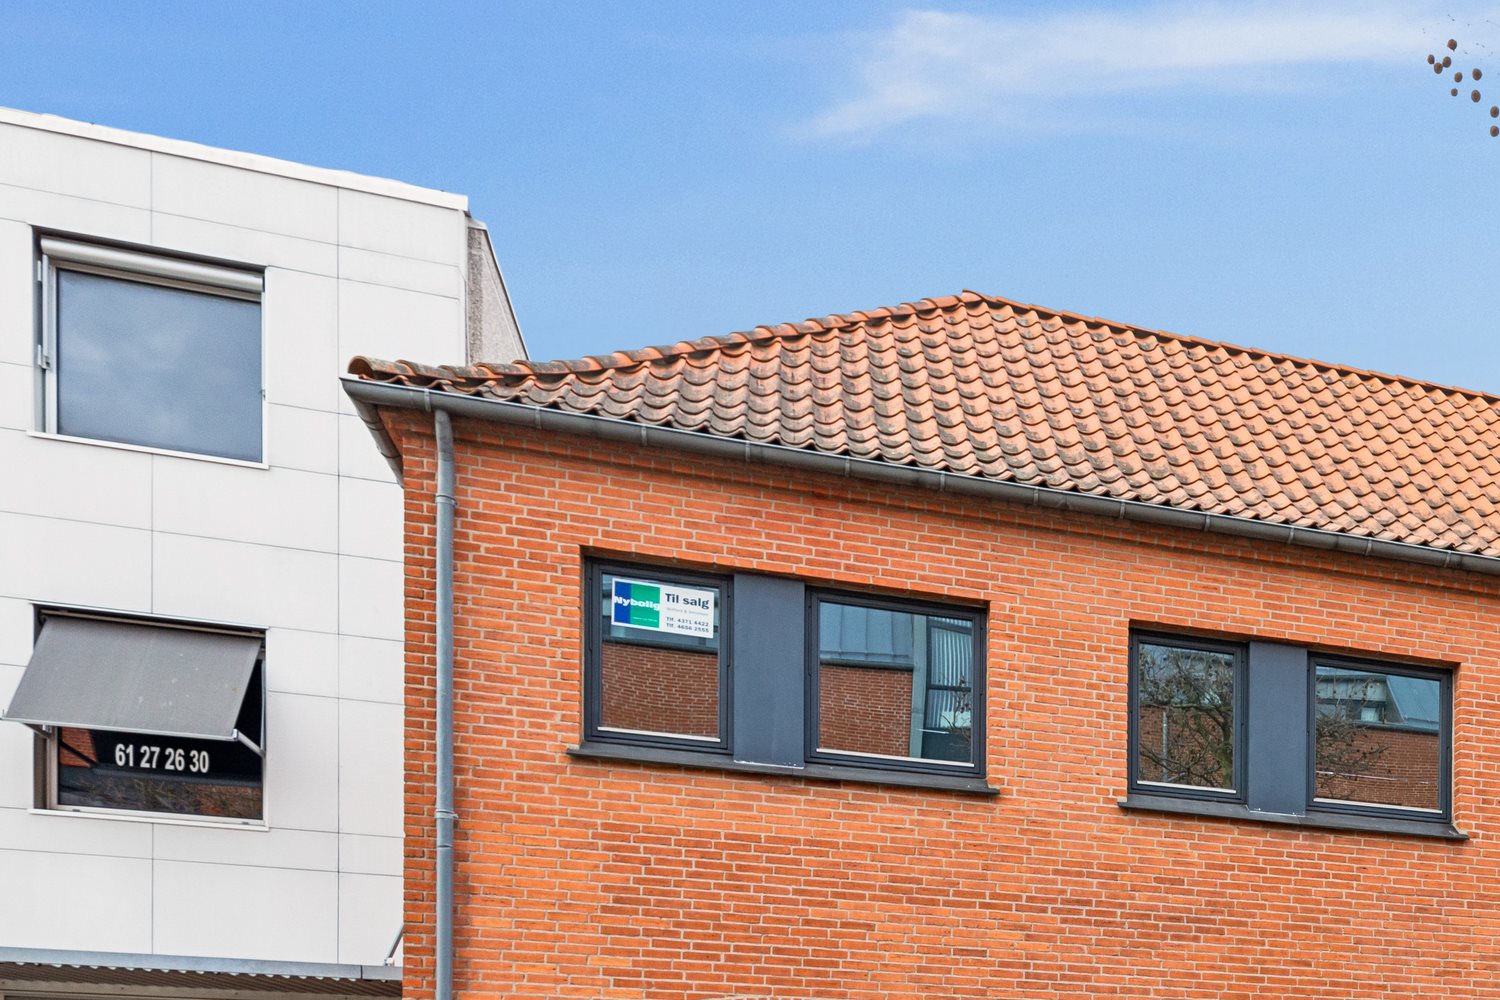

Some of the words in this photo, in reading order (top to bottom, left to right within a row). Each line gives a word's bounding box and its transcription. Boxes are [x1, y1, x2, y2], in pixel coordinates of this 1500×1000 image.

[614, 596, 660, 611] Nybolig
[665, 593, 679, 604] Til
[683, 597, 709, 609] salg
[115, 744, 134, 767] 61
[140, 746, 160, 768] 27
[164, 748, 185, 771] 26
[189, 750, 209, 773] 30
